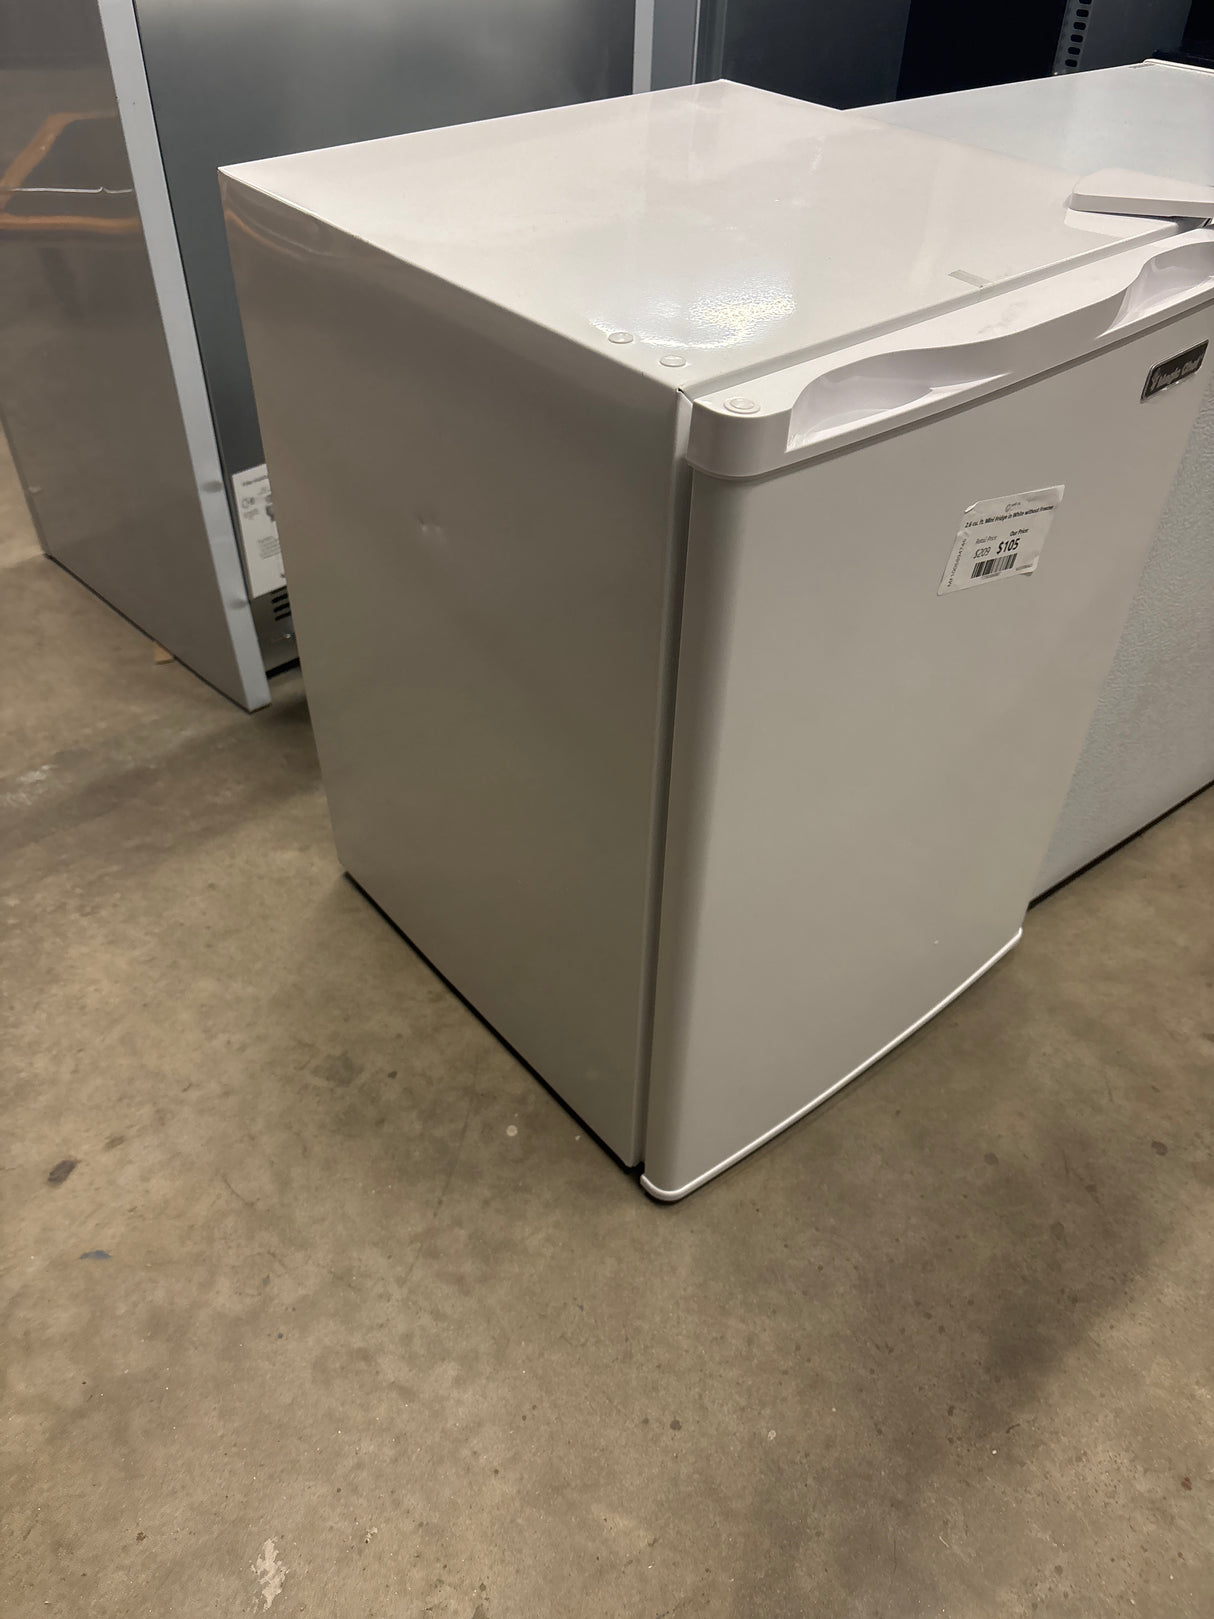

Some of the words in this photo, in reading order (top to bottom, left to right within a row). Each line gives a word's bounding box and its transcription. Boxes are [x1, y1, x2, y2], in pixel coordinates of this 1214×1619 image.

[994, 514, 1008, 522] Fridge
[973, 546, 992, 559] $209
[996, 537, 1020, 555] $105
